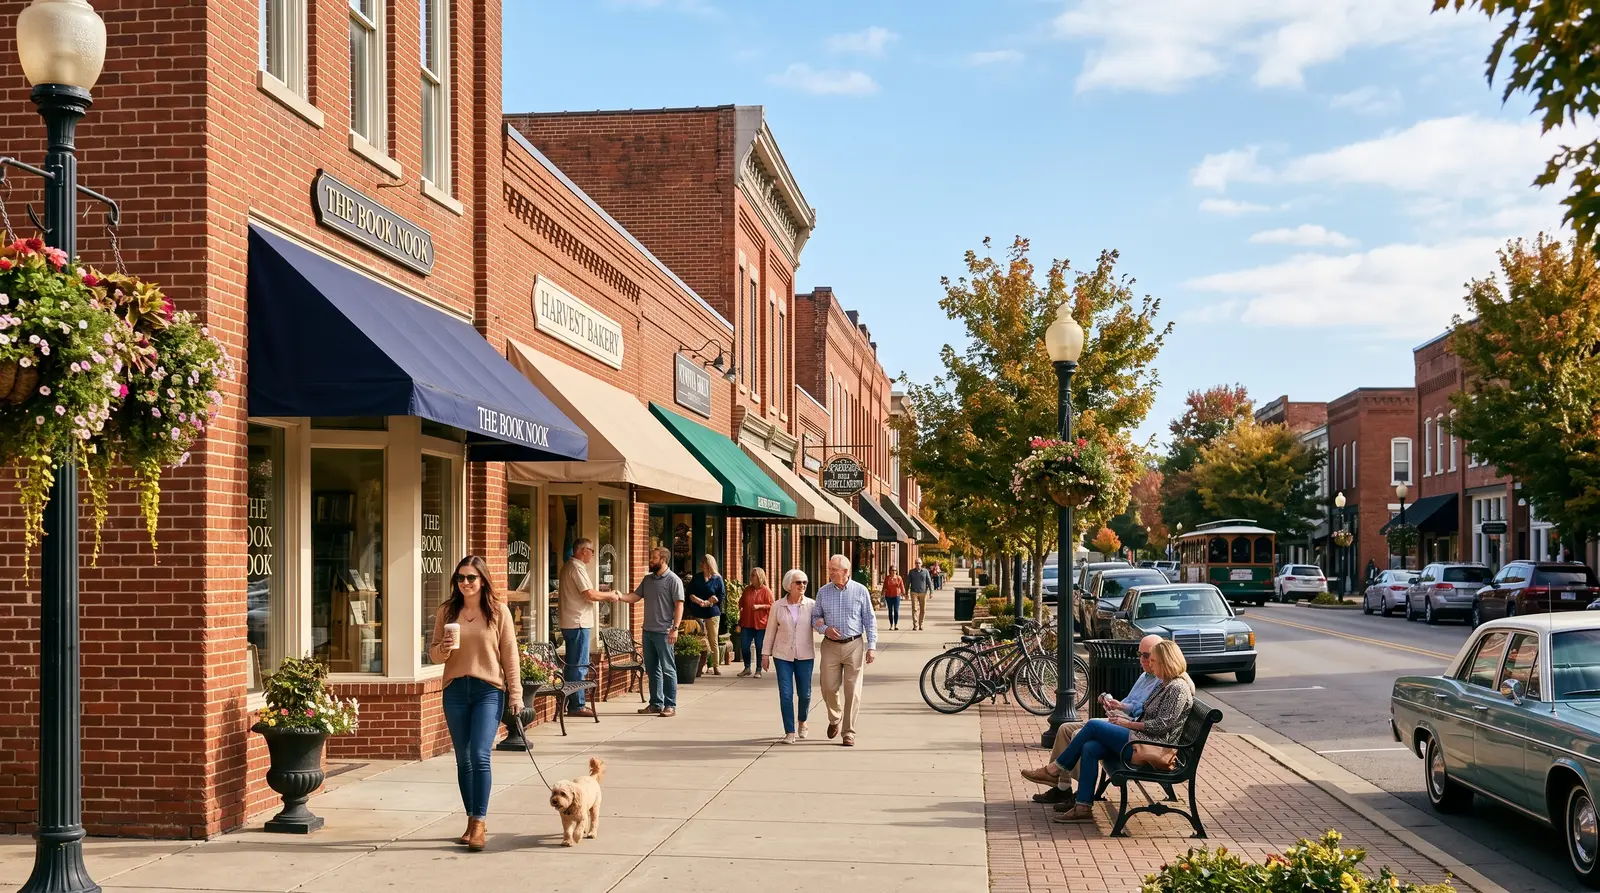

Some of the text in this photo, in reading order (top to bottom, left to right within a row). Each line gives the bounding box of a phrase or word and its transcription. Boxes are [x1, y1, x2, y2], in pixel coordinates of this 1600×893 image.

[325, 185, 429, 265] THE BOOK NOOK
[541, 290, 620, 357] HARVEST BAKERY
[477, 405, 550, 448] THE BOOK NOOK
[247, 497, 268, 519] HE
[423, 513, 440, 531] THE
[247, 525, 273, 547] OOK
[421, 535, 443, 552] BOOK
[247, 553, 273, 576] OOK
[420, 557, 443, 574] NOOK
